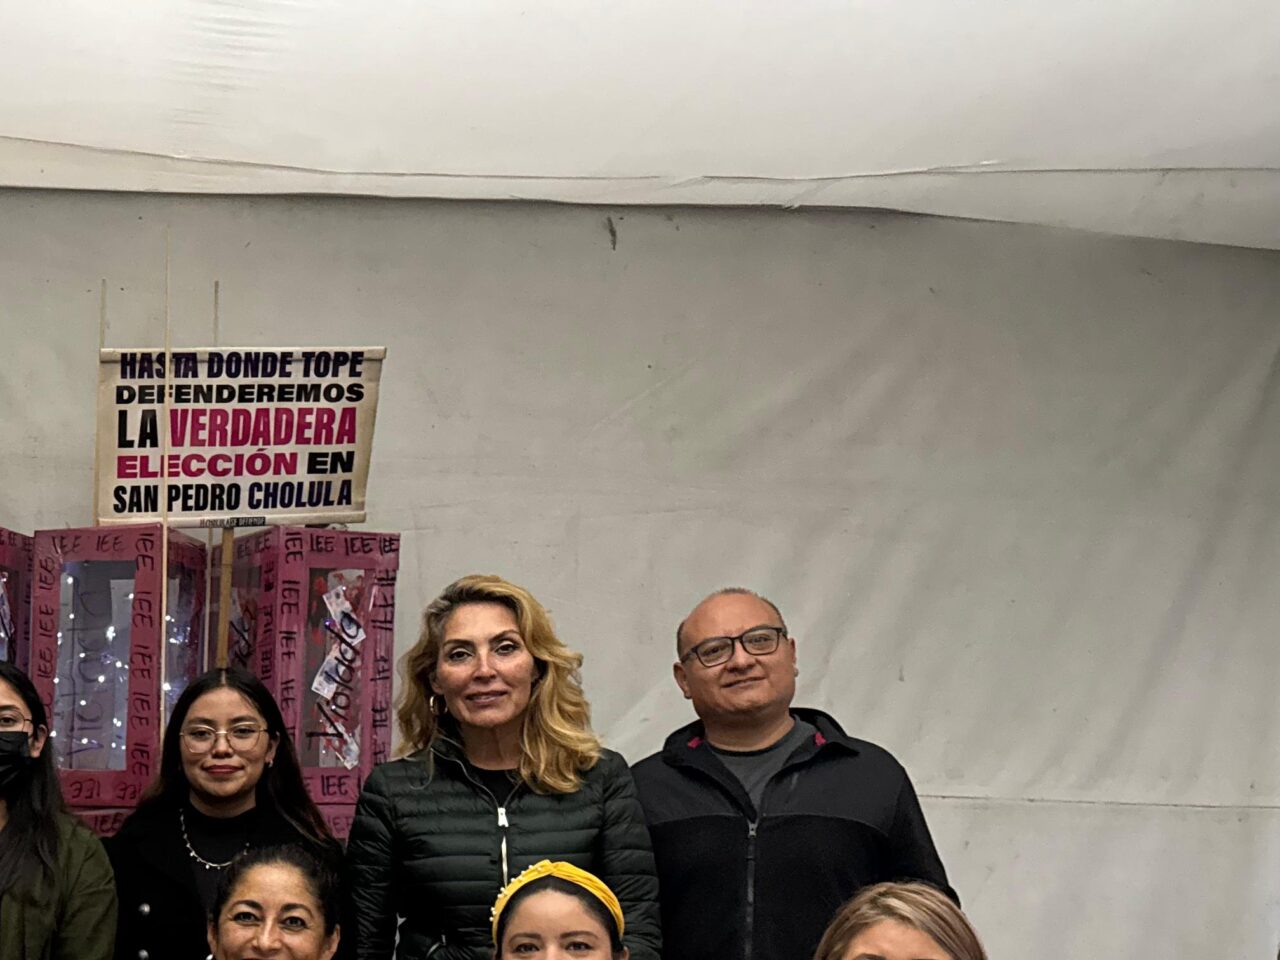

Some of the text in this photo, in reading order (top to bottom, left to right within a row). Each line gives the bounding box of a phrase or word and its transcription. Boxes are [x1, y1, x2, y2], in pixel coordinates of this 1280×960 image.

[120, 351, 364, 379] HASTA DONDE TOPE
[115, 383, 364, 404] DEFENDEREMOS
[117, 407, 357, 448] LA VERDADERA
[117, 448, 355, 479] ELECCIÓN EN
[113, 480, 352, 513] SAN PEDRO CHOLULA
[96, 533, 123, 552] IEE
[284, 531, 304, 564] IEE
[310, 533, 335, 553] IEE
[344, 536, 377, 556] IEE
[281, 580, 300, 615] IEE
[130, 532, 155, 777] IEE IEE IEE IEE IEE
[306, 611, 362, 738] Violada
[322, 776, 349, 796] IEE
